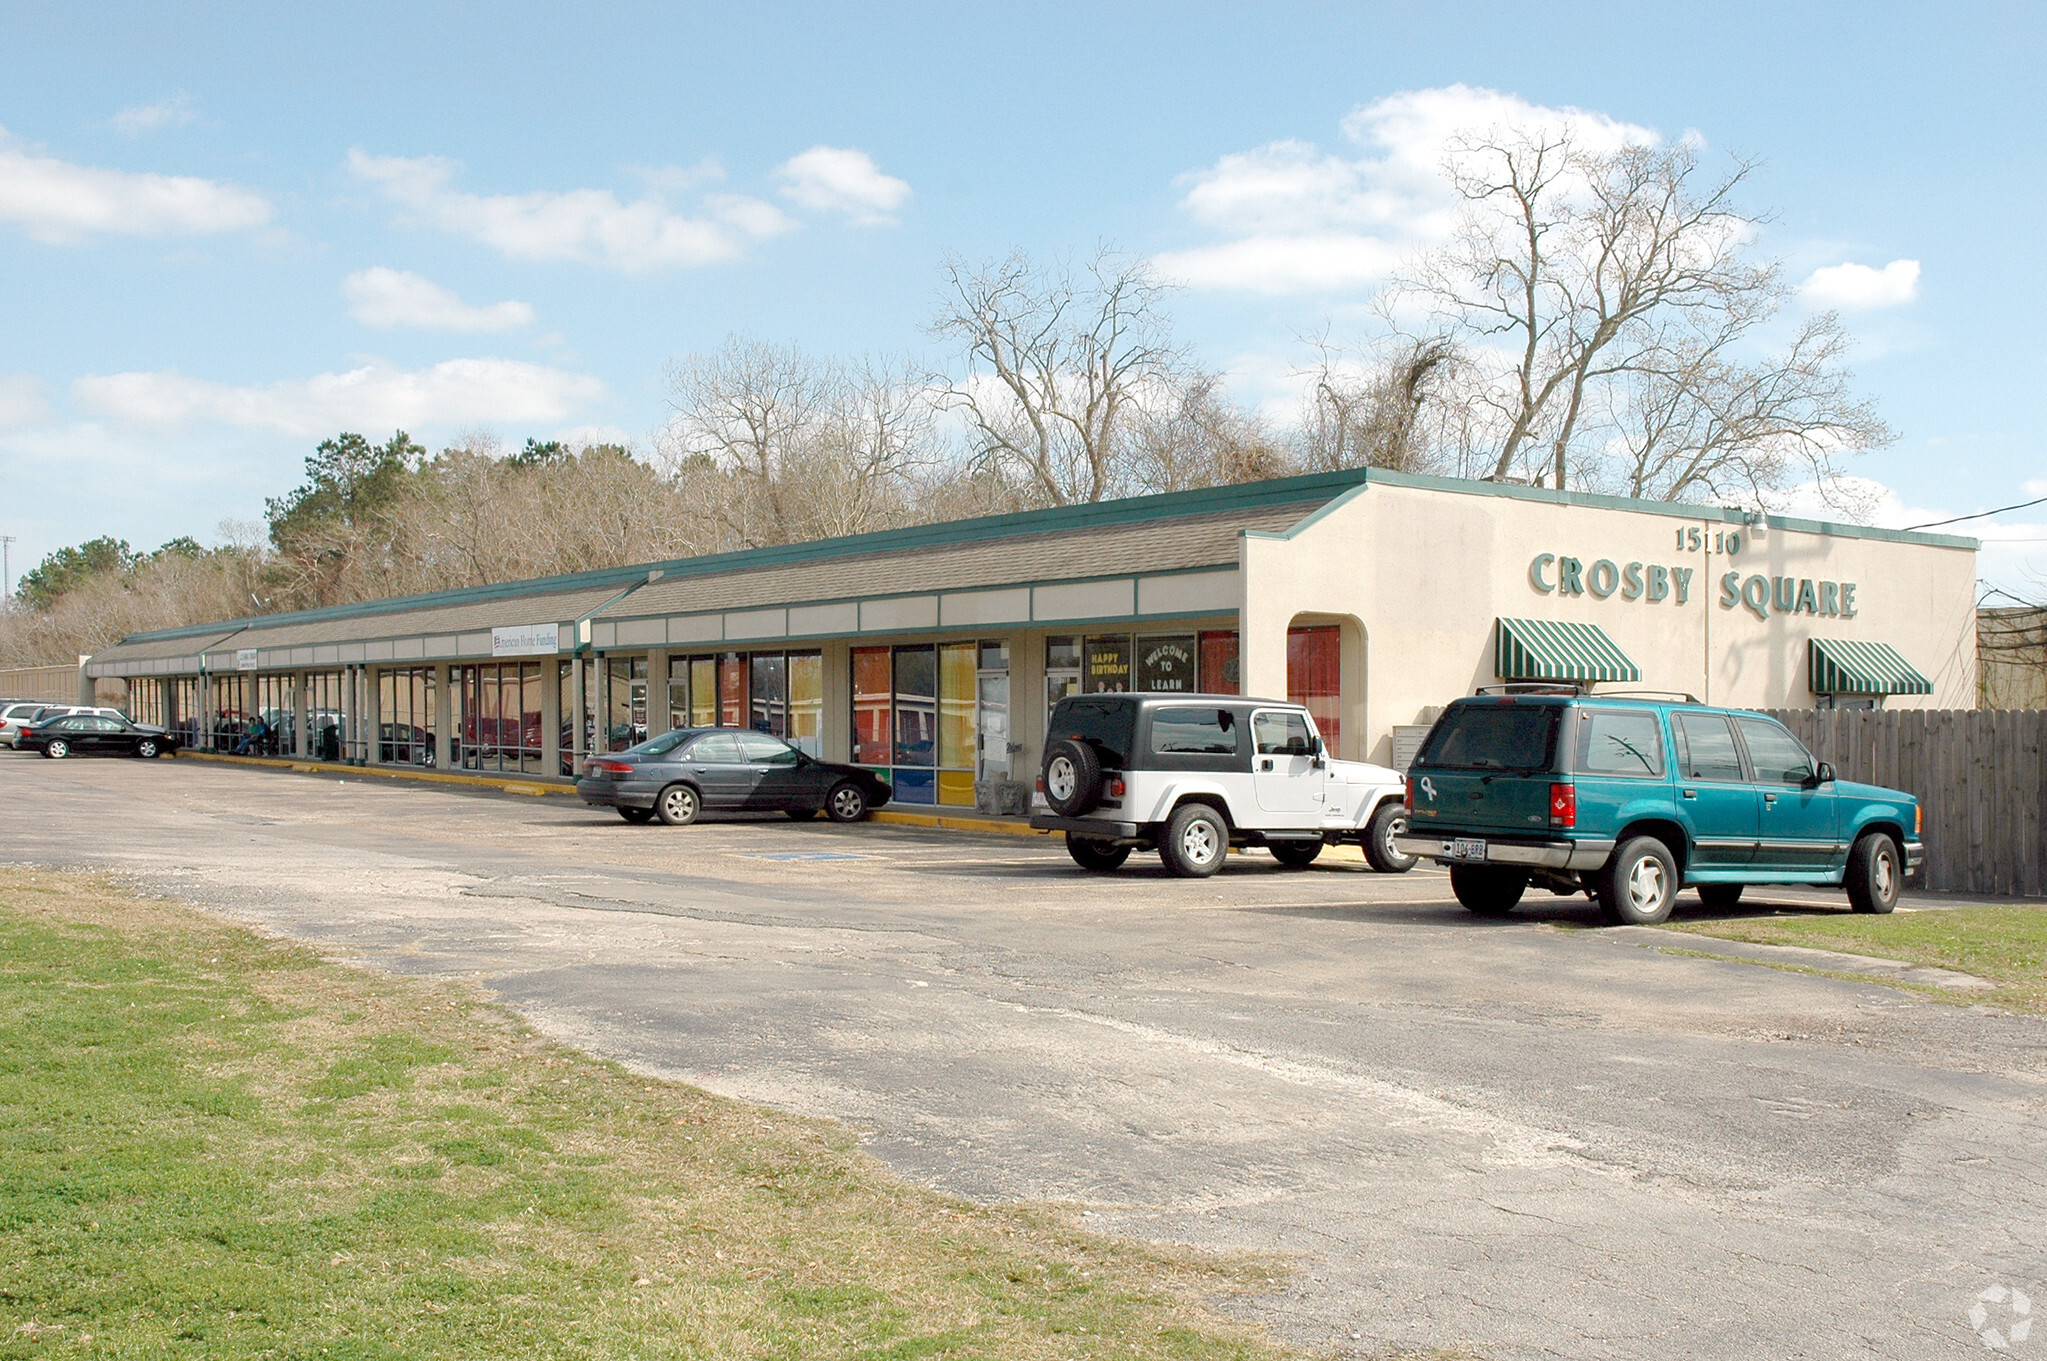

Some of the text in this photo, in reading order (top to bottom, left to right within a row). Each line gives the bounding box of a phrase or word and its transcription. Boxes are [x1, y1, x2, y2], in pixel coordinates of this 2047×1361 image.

[1529, 552, 1858, 621] CROSBY SQUARE
[1091, 653, 1119, 664] HAPPY
[1145, 645, 1188, 666] WELCOME
[1091, 664, 1129, 675] BIRTHDAY
[1160, 661, 1172, 672] TO
[1151, 679, 1182, 690] LEARN
